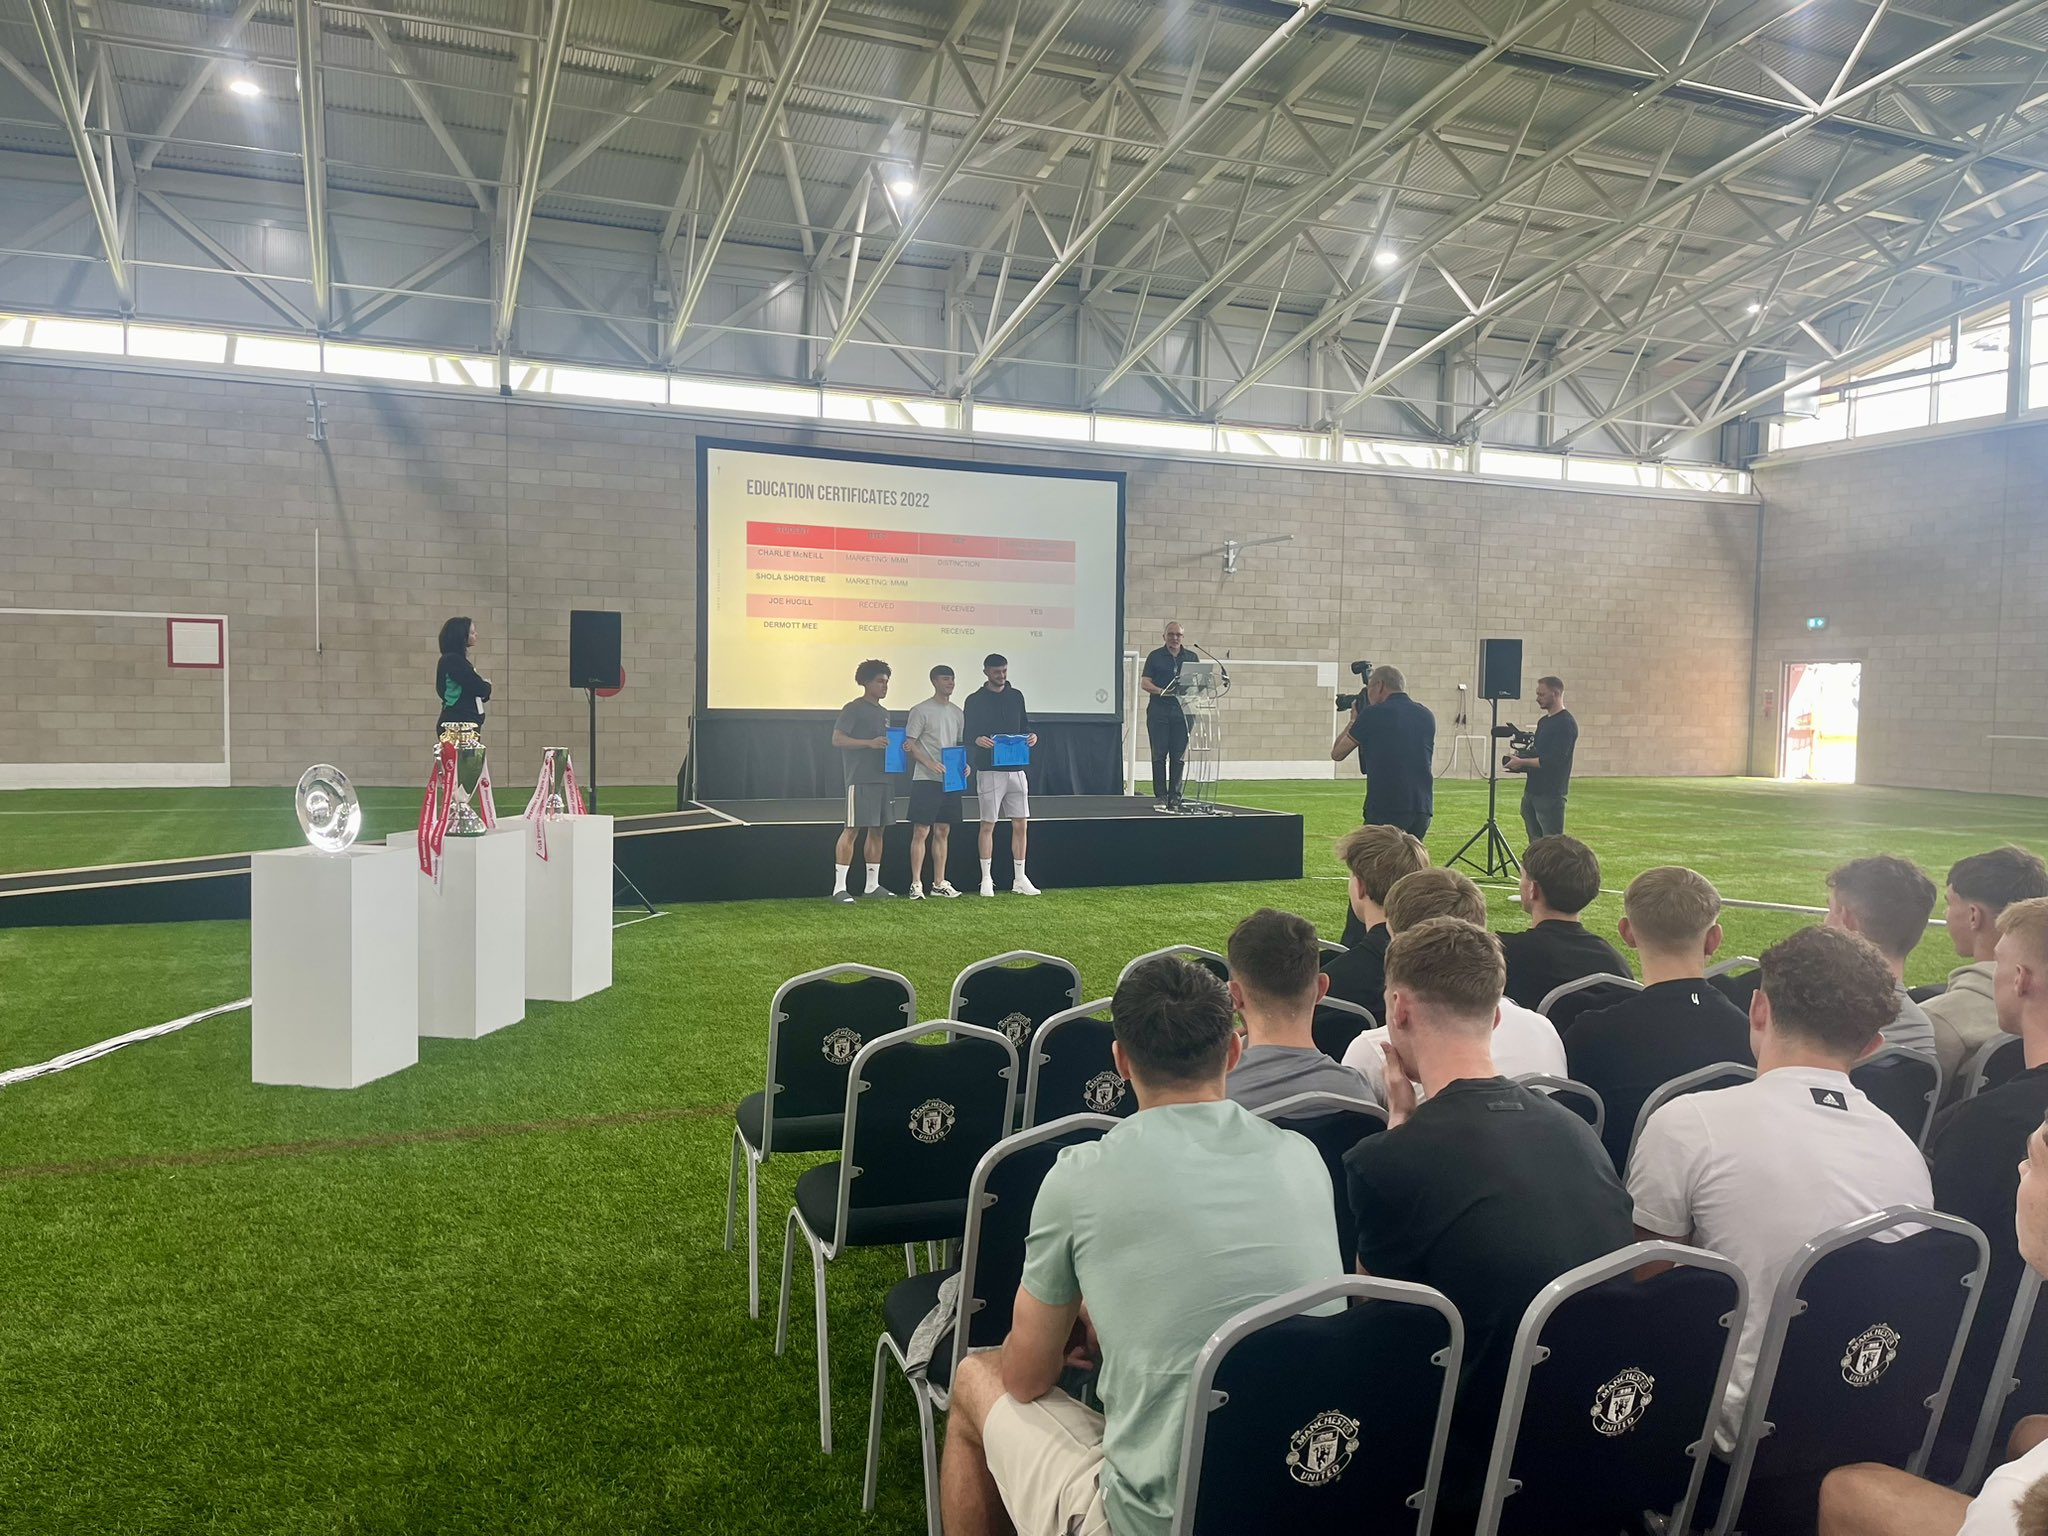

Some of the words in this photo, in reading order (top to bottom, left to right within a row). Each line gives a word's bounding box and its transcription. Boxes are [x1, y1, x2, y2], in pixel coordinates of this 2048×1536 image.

[747, 479, 814, 500] EDUCATION
[817, 485, 897, 506] CERTIFICATES
[900, 491, 930, 508] 2022
[758, 549, 790, 558] CHARLIE
[792, 551, 824, 560] McNEILL
[891, 556, 909, 564] MMM
[937, 559, 980, 568] DISTINCTION
[756, 572, 782, 581] SHOLA
[783, 574, 826, 583] SHORETIRE
[891, 579, 909, 587] MMM
[786, 598, 813, 606] HUGILL
[859, 601, 895, 609] RECEIVED
[941, 605, 976, 613] RECEIVED
[763, 621, 800, 629] DERMOTT
[802, 622, 818, 630] MEE
[859, 624, 895, 633] RECEIVED
[941, 628, 976, 636] RECEIVED
[526, 800, 537, 820] Premier
[535, 781, 545, 800] League
[1851, 1328, 1895, 1351] MANCHESTER
[1849, 1370, 1879, 1382] UNITED
[1601, 1373, 1649, 1398] MANCHESTER
[1600, 1417, 1634, 1432] UNITED
[1296, 1416, 1354, 1445] MANCHESTER
[1300, 1464, 1340, 1481] UNITED
